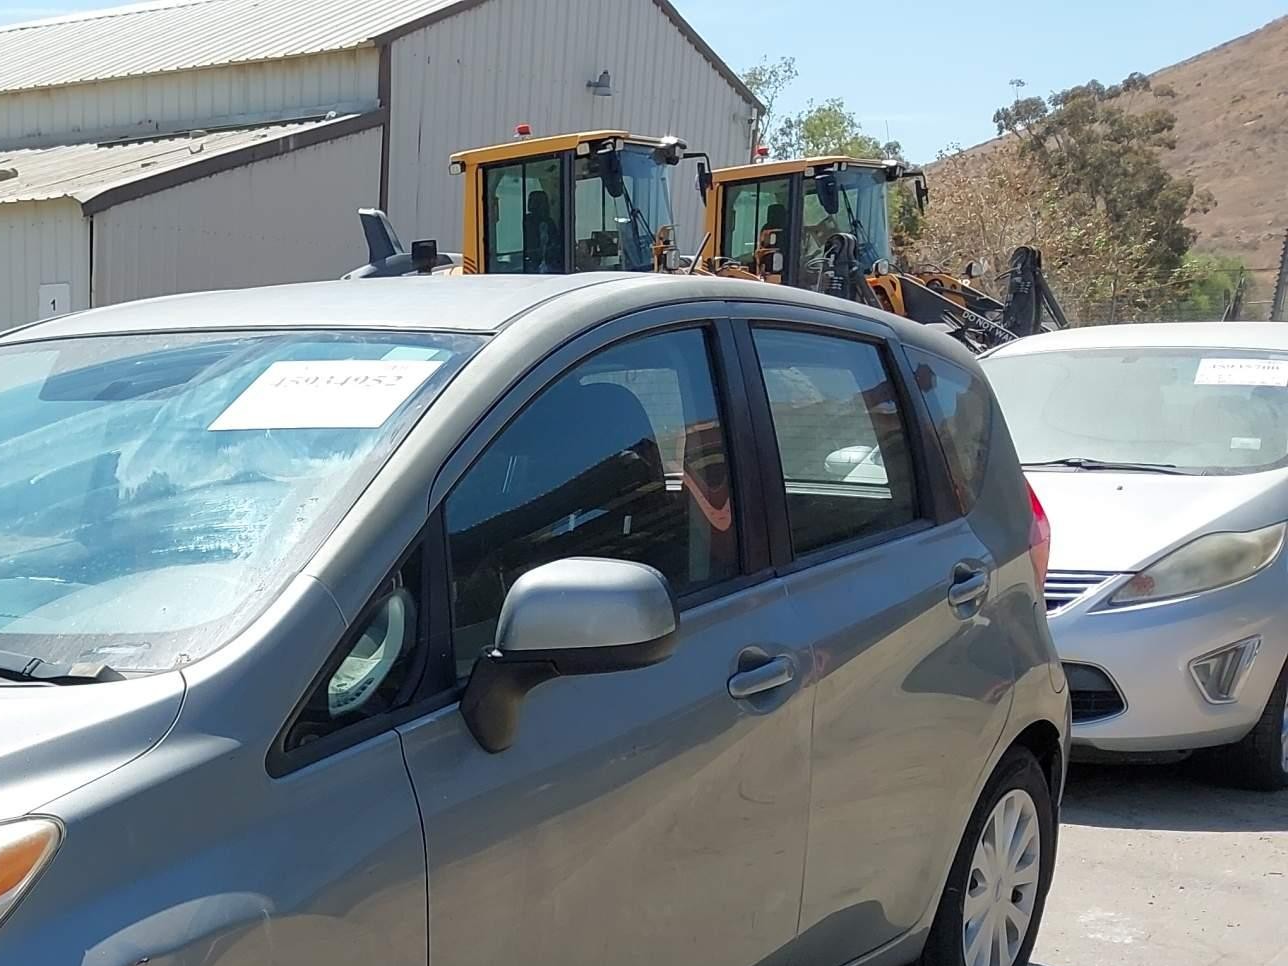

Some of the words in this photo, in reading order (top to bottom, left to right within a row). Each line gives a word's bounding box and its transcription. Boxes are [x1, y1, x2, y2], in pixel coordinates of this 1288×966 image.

[50, 299, 56, 312] 1
[962, 310, 976, 322] DO
[975, 318, 995, 332] NOT
